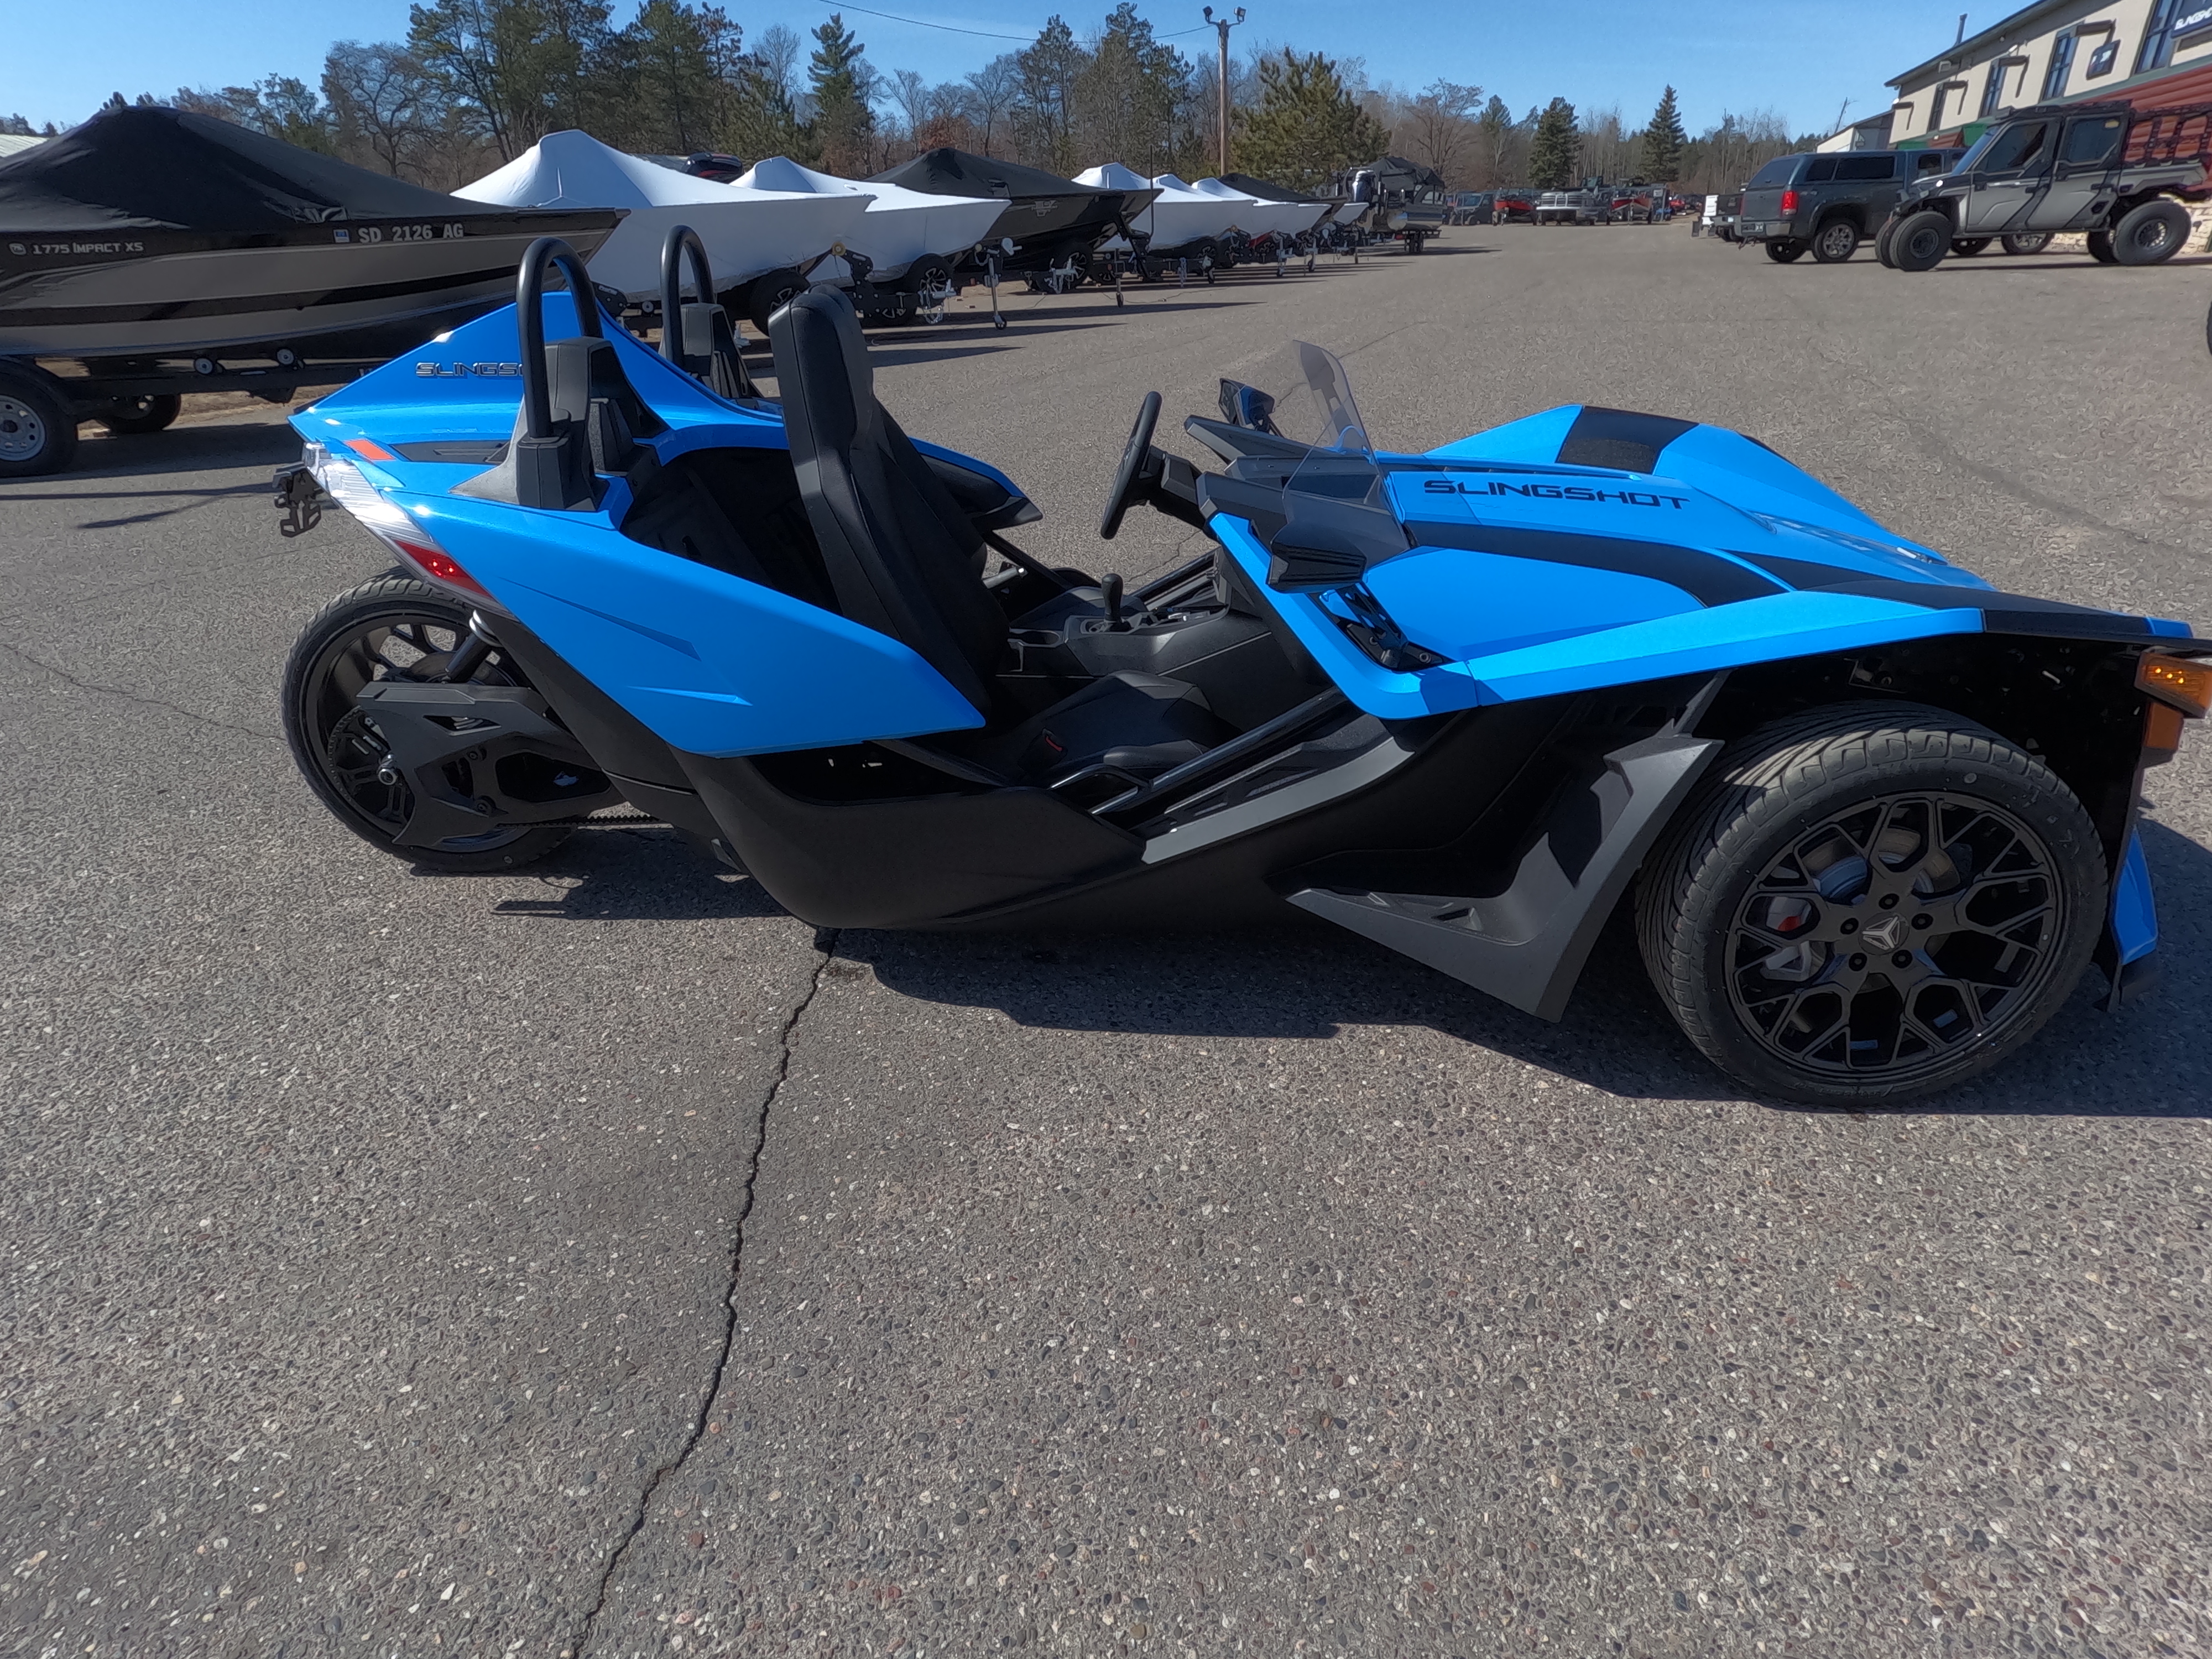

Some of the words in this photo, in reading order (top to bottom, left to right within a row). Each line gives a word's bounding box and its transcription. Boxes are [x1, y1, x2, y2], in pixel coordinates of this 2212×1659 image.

[358, 227, 382, 243] SD
[392, 225, 433, 242] 2126
[442, 223, 464, 238] AG
[33, 244, 70, 254] 1775
[72, 242, 121, 253] IMPACT
[125, 242, 144, 252] XS
[416, 362, 523, 377] SLINGS
[1424, 479, 1691, 509] SLINGSHOT
